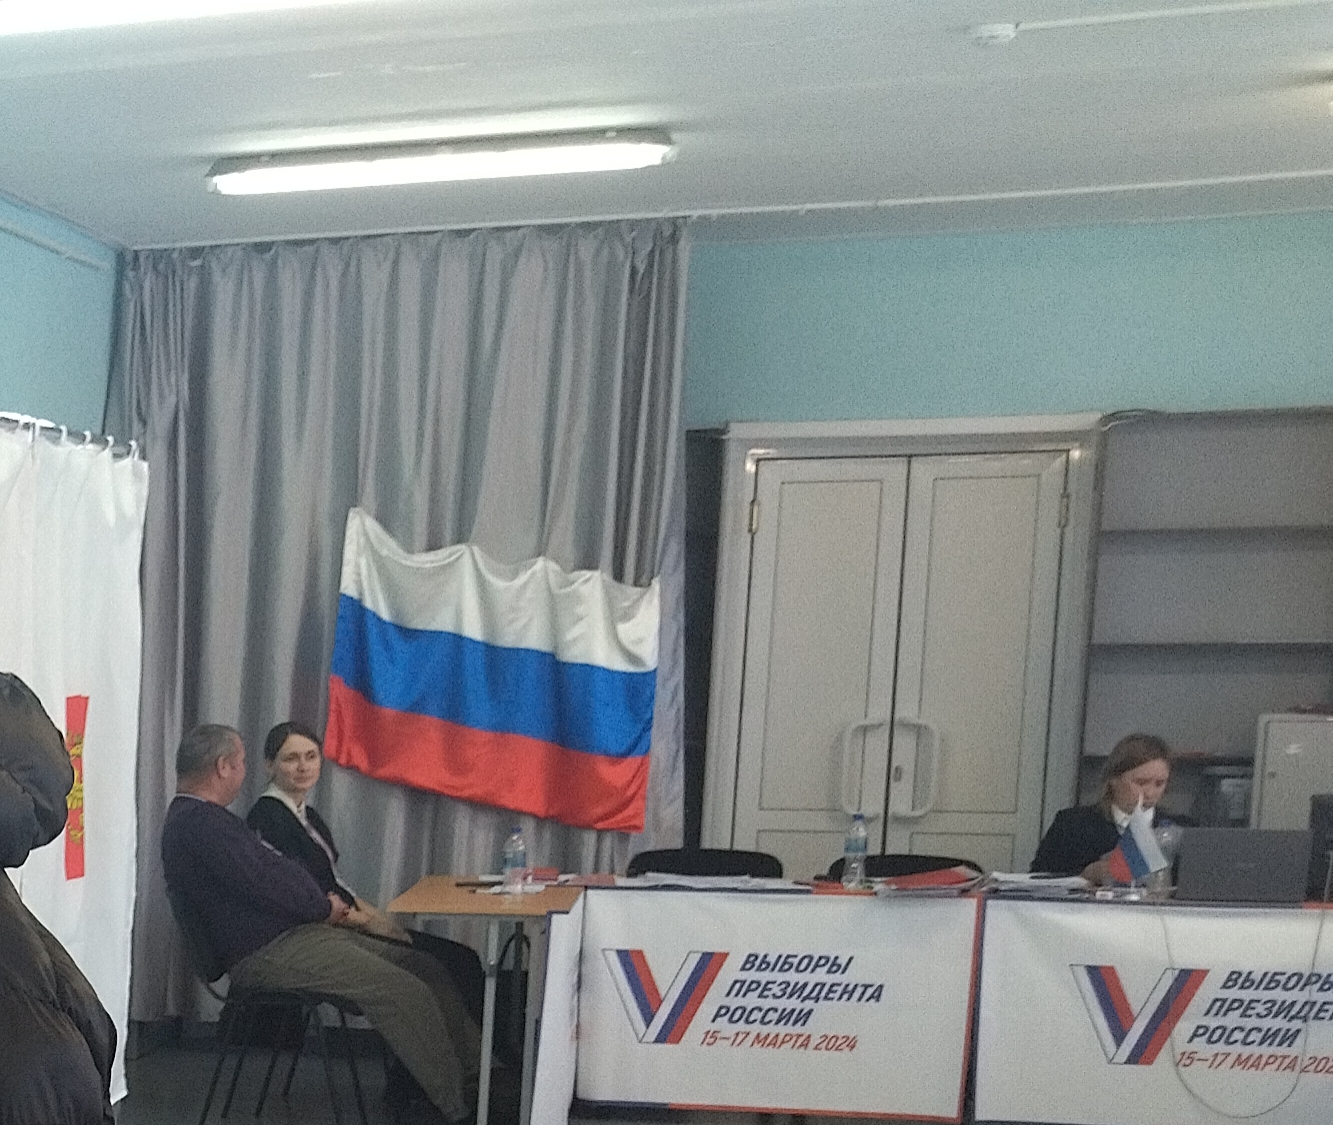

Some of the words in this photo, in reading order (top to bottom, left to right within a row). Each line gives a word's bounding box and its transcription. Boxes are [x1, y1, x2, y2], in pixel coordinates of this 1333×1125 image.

[739, 953, 854, 975] ВЫБОРЫ
[725, 979, 885, 1004] ПРЕЗИДЕНТА
[711, 1005, 814, 1027] РОССИИ
[1203, 997, 1333, 1024] ПРЕЗИДЕ
[751, 1032, 812, 1050] МАРТА
[813, 1034, 858, 1052] 2024
[1187, 1025, 1302, 1048] РОССИИ
[1230, 1053, 1300, 1072] МАРТА
